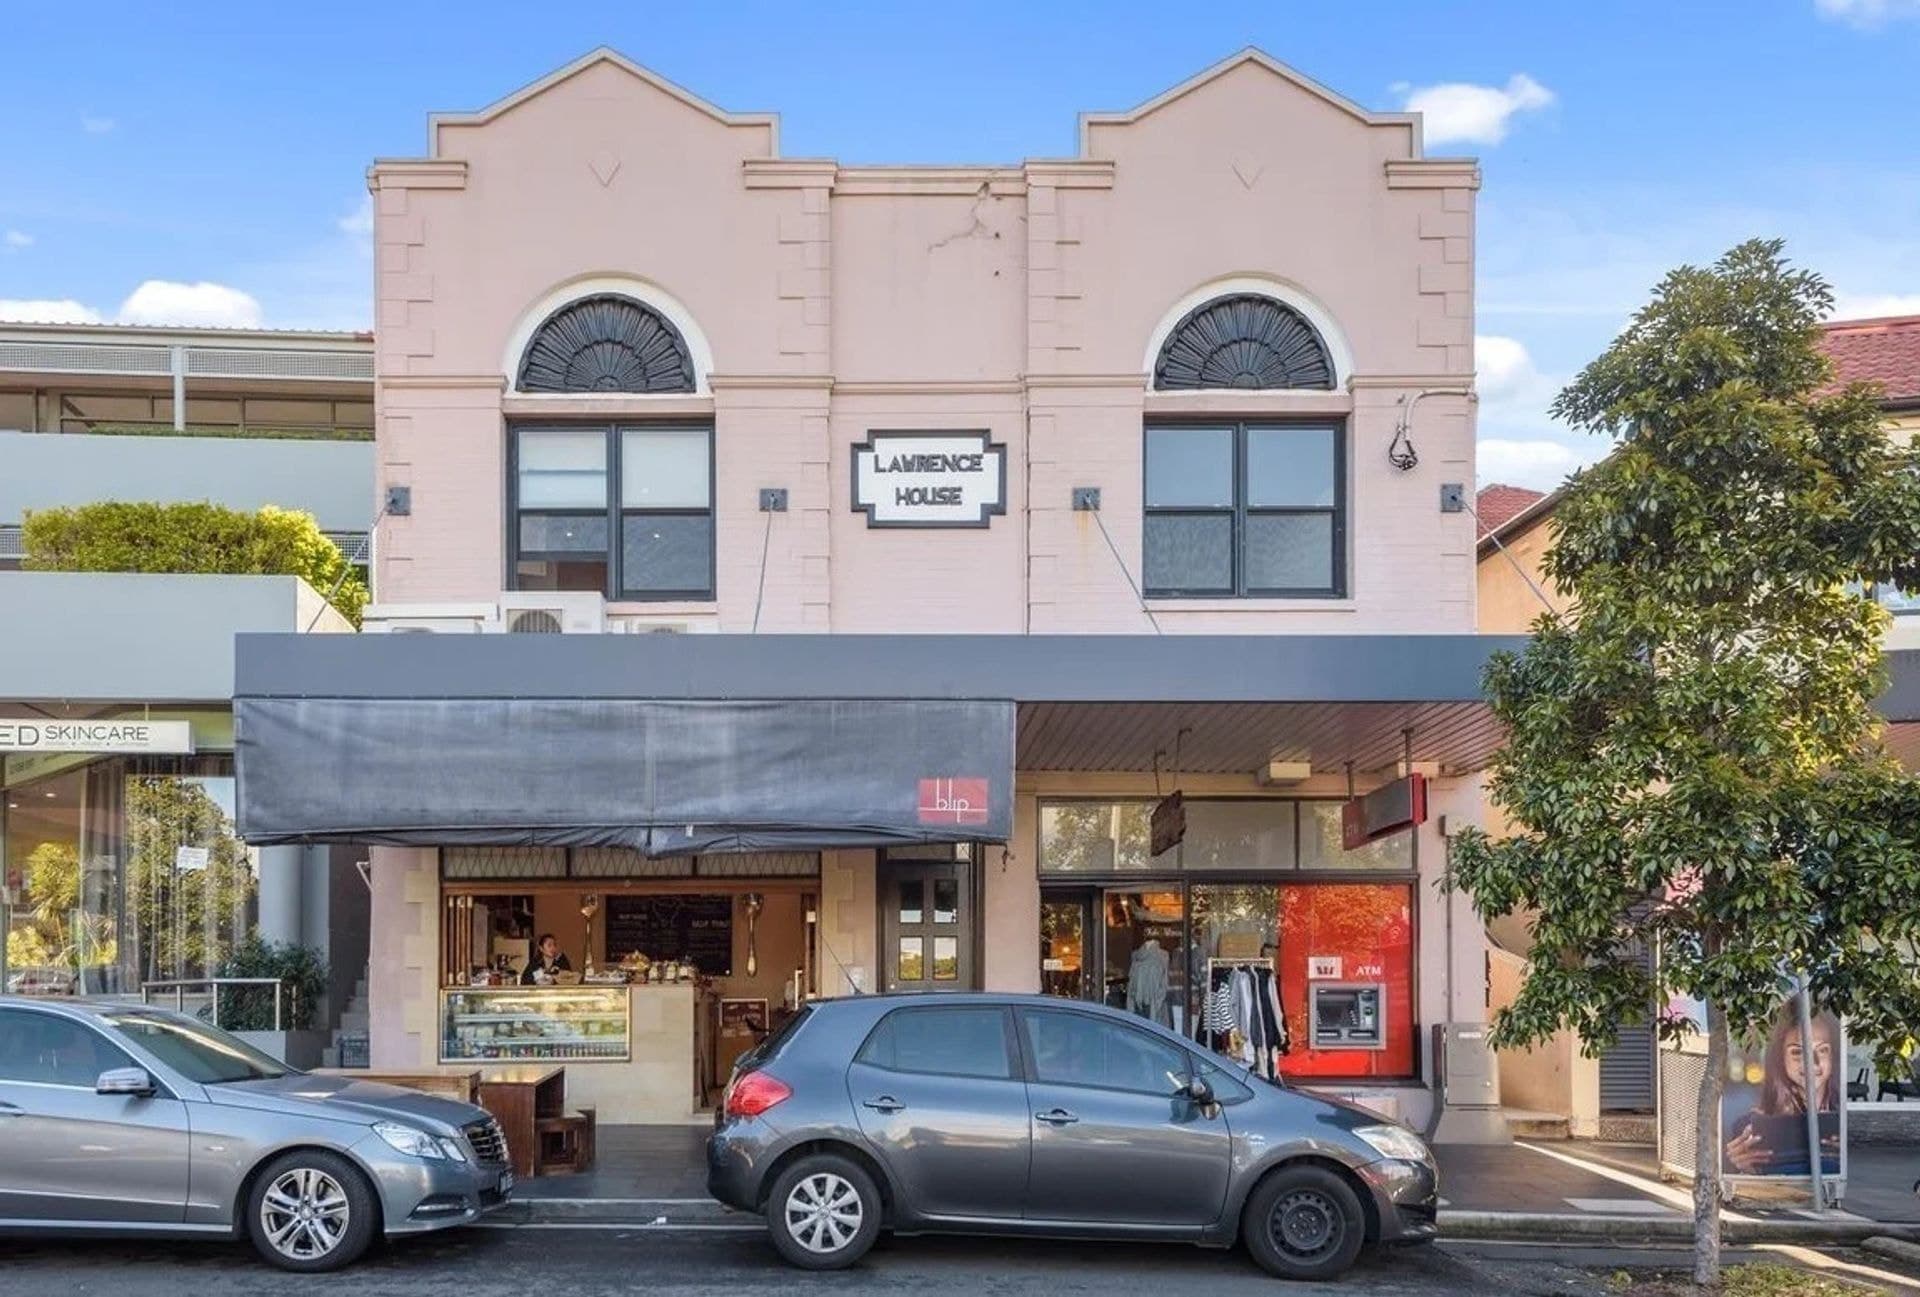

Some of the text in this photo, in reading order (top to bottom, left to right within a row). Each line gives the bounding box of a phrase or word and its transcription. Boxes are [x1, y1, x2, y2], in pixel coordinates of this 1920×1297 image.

[874, 454, 983, 472] LAWRENCE
[895, 486, 962, 506] HOUSE
[45, 726, 149, 740] SKINCARE
[936, 778, 969, 824] blip
[1356, 966, 1381, 976] ATM
